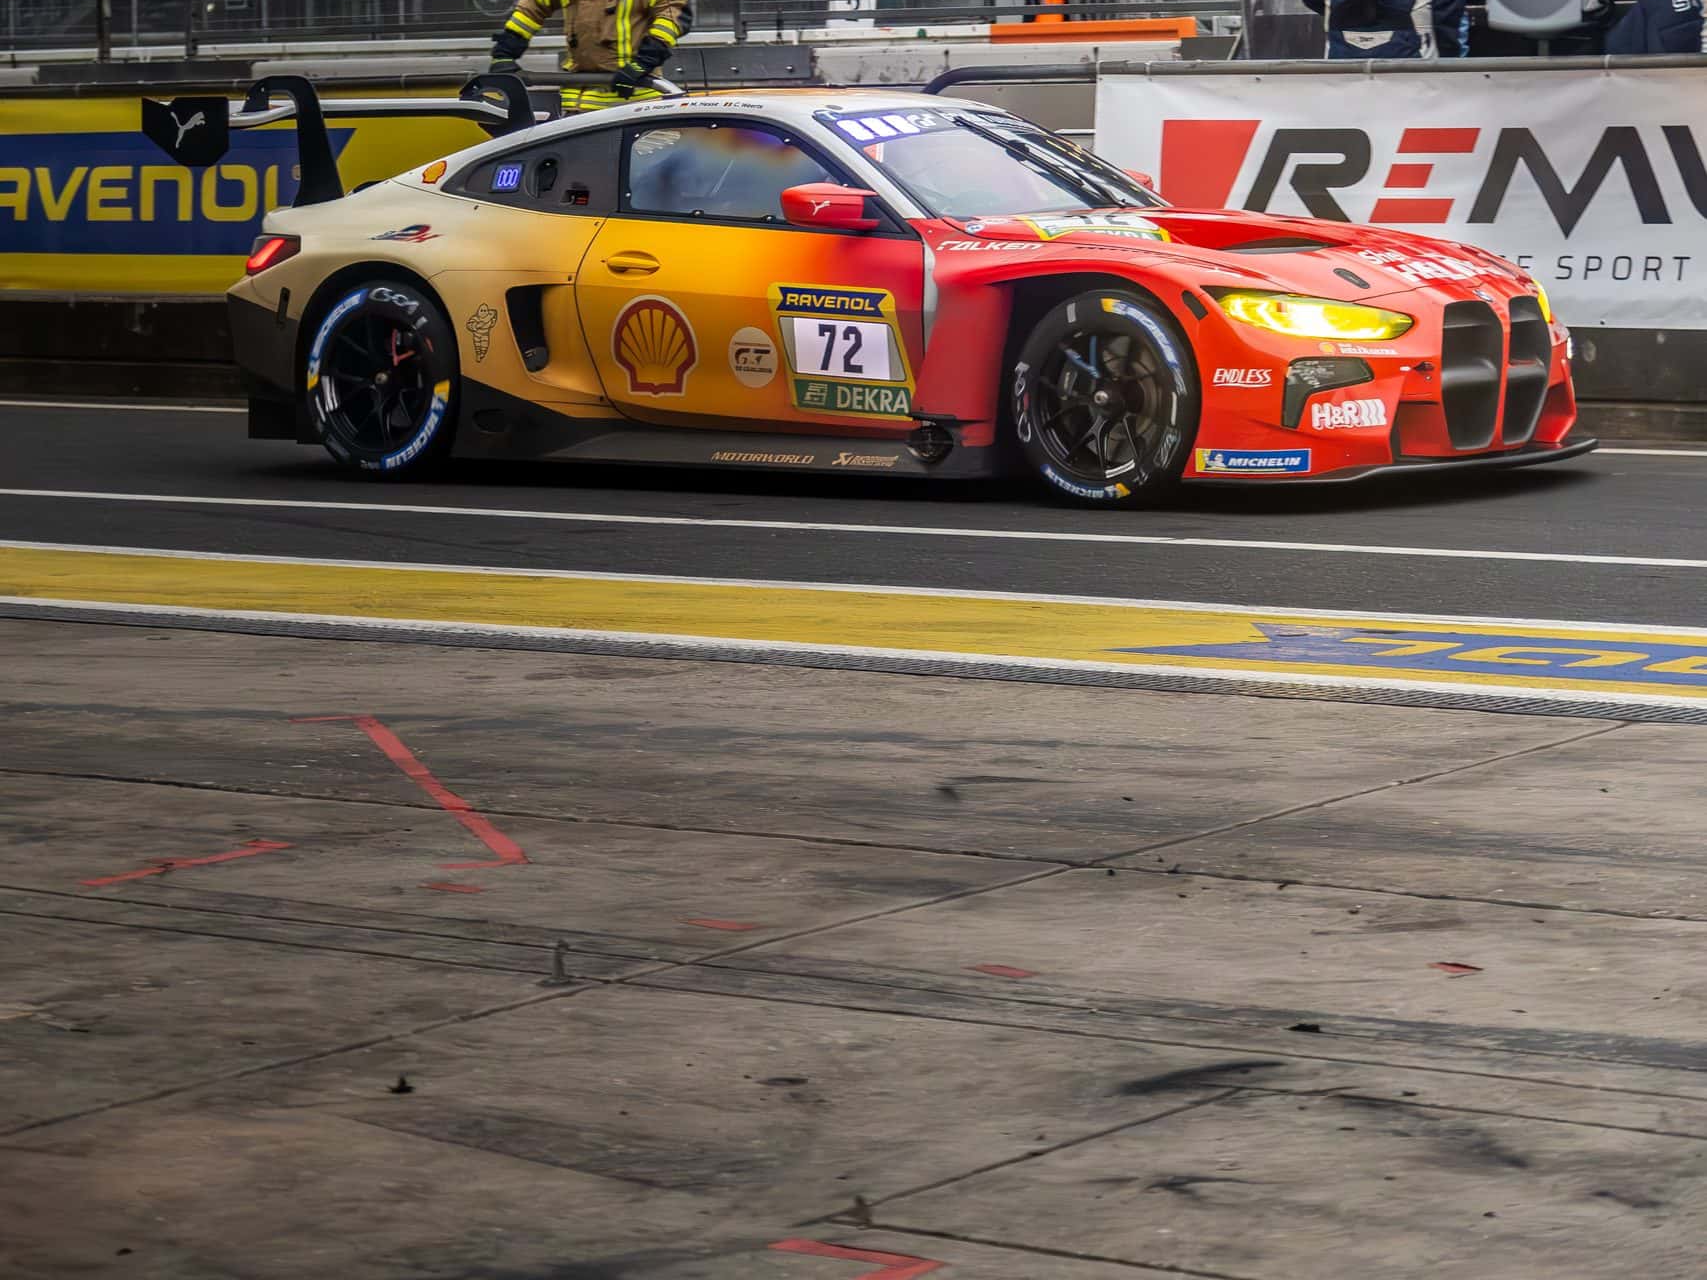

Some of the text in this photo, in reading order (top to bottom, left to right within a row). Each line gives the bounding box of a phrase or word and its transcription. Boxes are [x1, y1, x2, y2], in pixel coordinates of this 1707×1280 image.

[936, 239, 1045, 252] FALKEN
[1555, 254, 1692, 282] SPORT
[786, 293, 876, 311] RAVENOL
[818, 323, 864, 374] 72
[1213, 367, 1272, 385] ENDLESS
[836, 385, 909, 414] DEKRA
[1312, 400, 1359, 430] H&R
[711, 451, 815, 465] MOTORWORLD
[1228, 456, 1302, 467] MICHELIN
